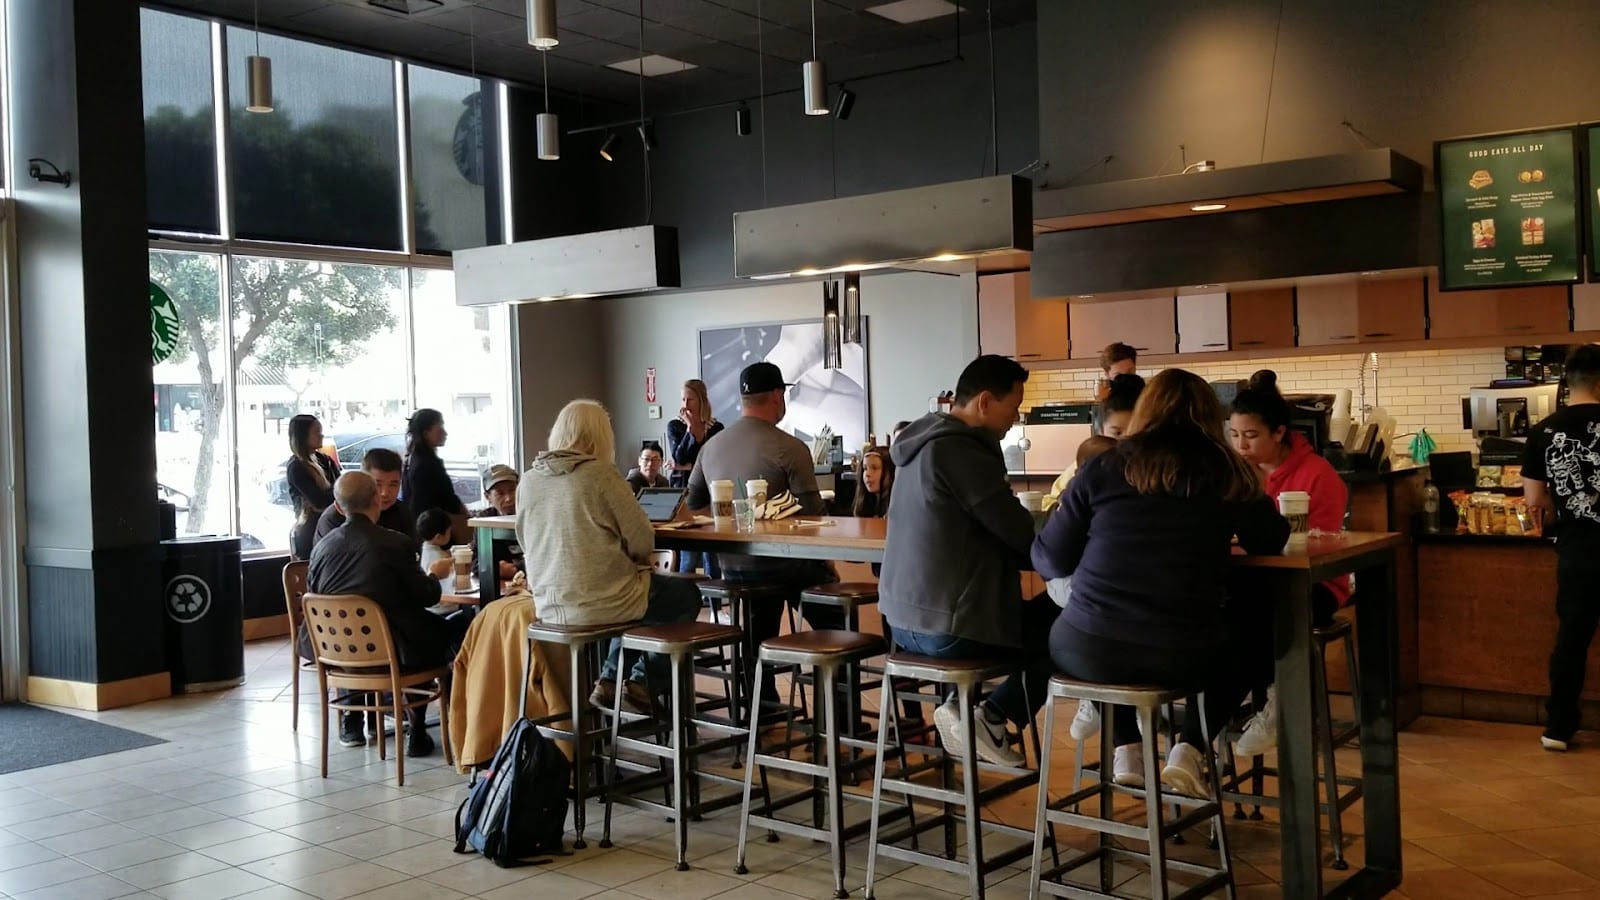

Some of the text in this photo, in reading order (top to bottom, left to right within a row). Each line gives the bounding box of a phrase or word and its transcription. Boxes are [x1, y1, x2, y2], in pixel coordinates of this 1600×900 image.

[1469, 144, 1544, 158] GOOD EATS ALL DAY
